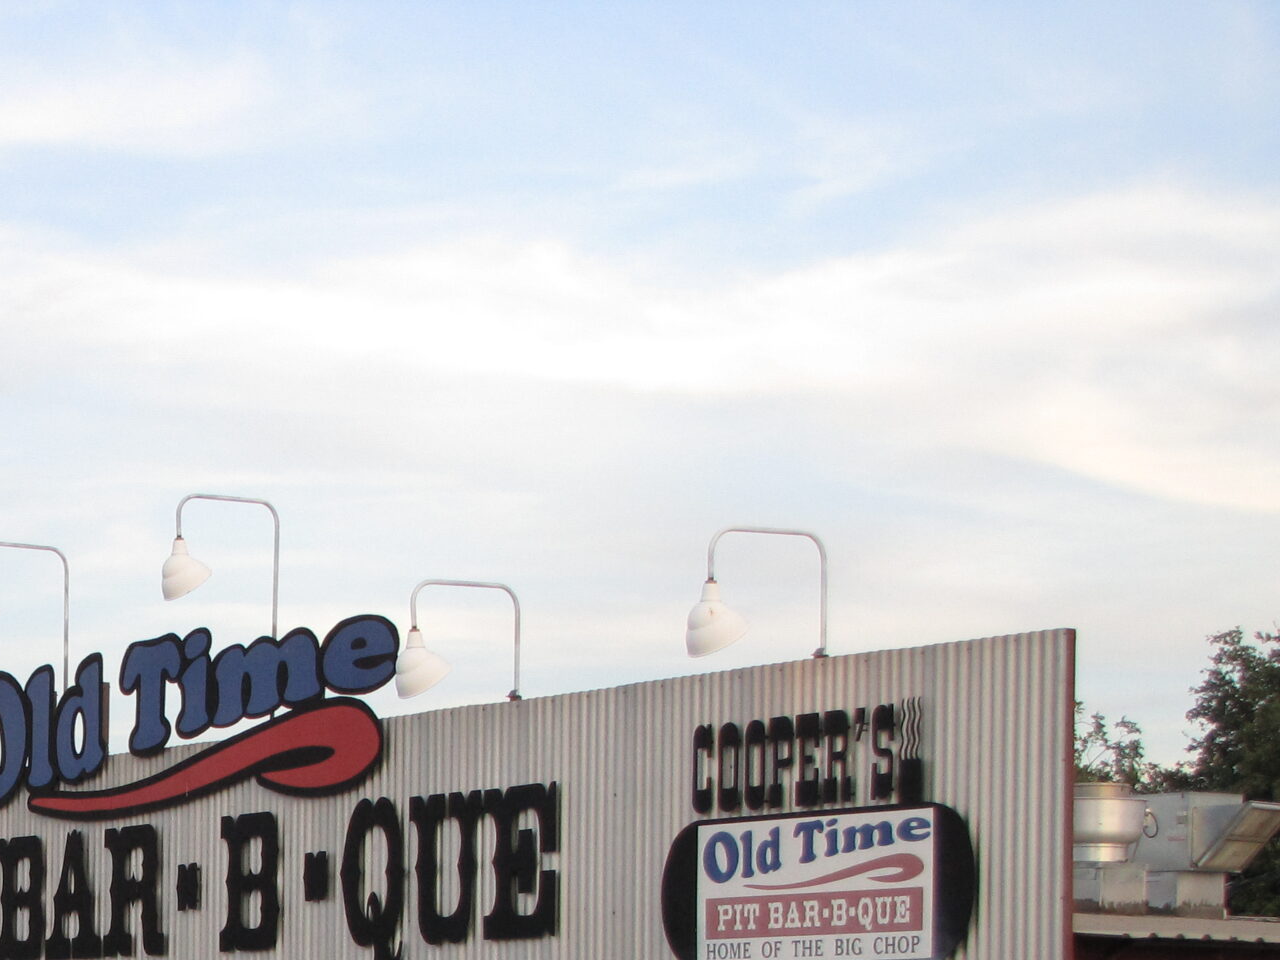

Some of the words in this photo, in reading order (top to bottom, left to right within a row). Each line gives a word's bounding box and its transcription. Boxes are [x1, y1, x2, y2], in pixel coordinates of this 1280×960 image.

[120, 614, 400, 758] Time
[692, 703, 895, 815] COOPER'S
[703, 826, 782, 884] Old
[793, 816, 932, 864] Time
[706, 941, 751, 960] HOME
[761, 941, 782, 960] OF
[792, 939, 824, 958] THE
[834, 937, 863, 957] BIG
[873, 935, 921, 955] CHOP
[716, 903, 759, 931] PIT
